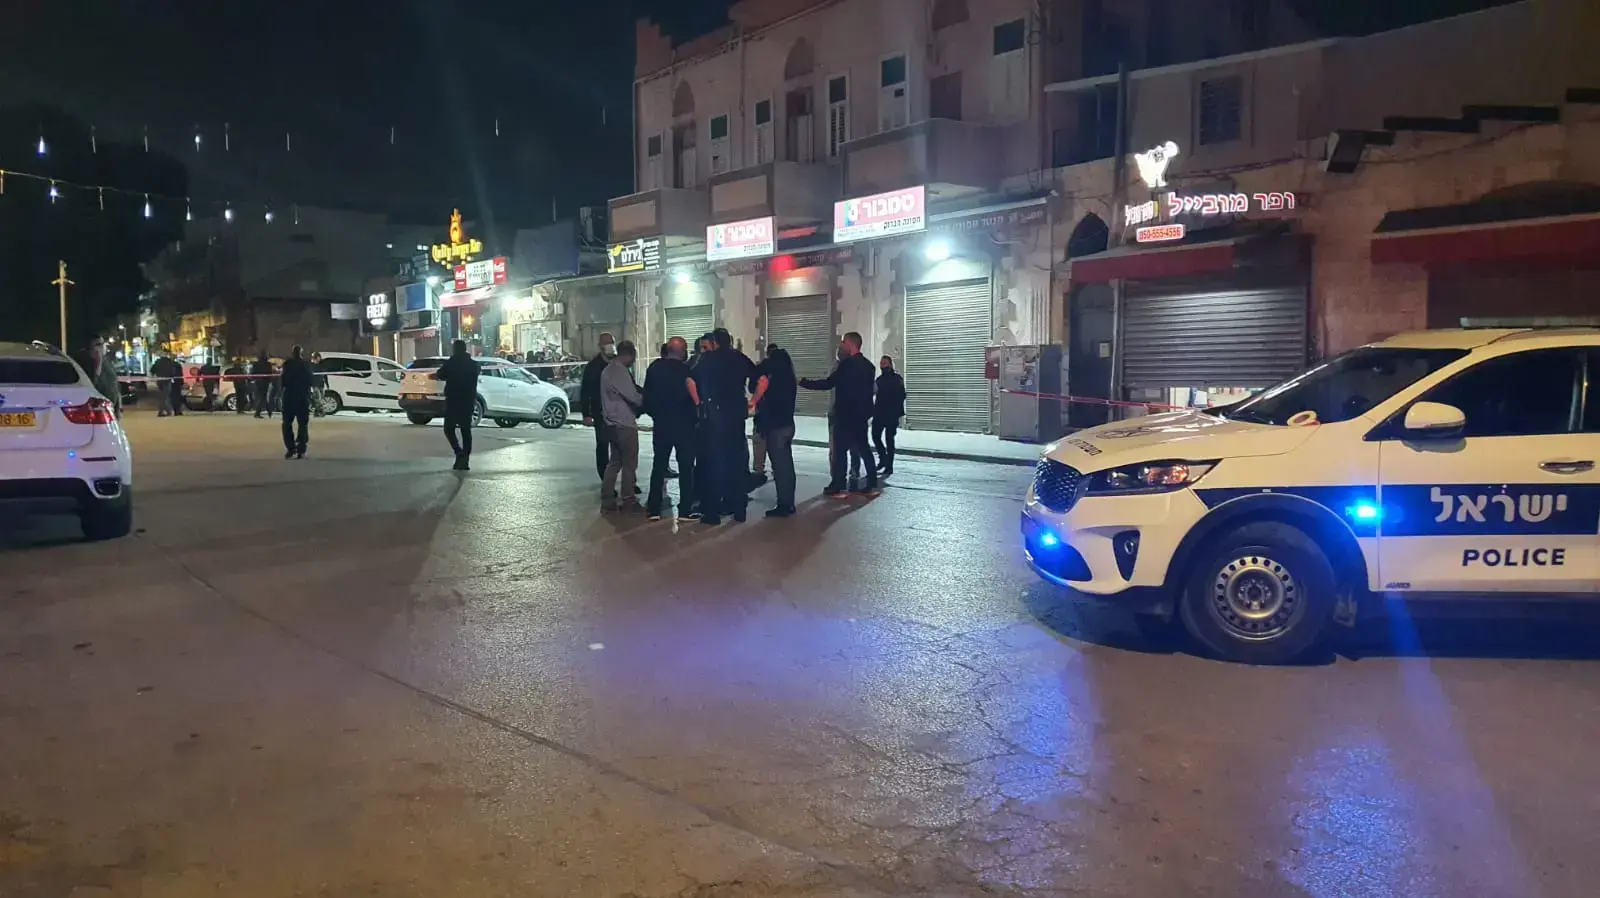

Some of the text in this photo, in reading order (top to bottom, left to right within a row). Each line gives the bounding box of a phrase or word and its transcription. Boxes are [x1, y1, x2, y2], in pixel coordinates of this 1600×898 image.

[1167, 191, 1249, 217] מובייל
[1430, 486, 1568, 523] ישראל
[1461, 548, 1567, 567] POLICE
